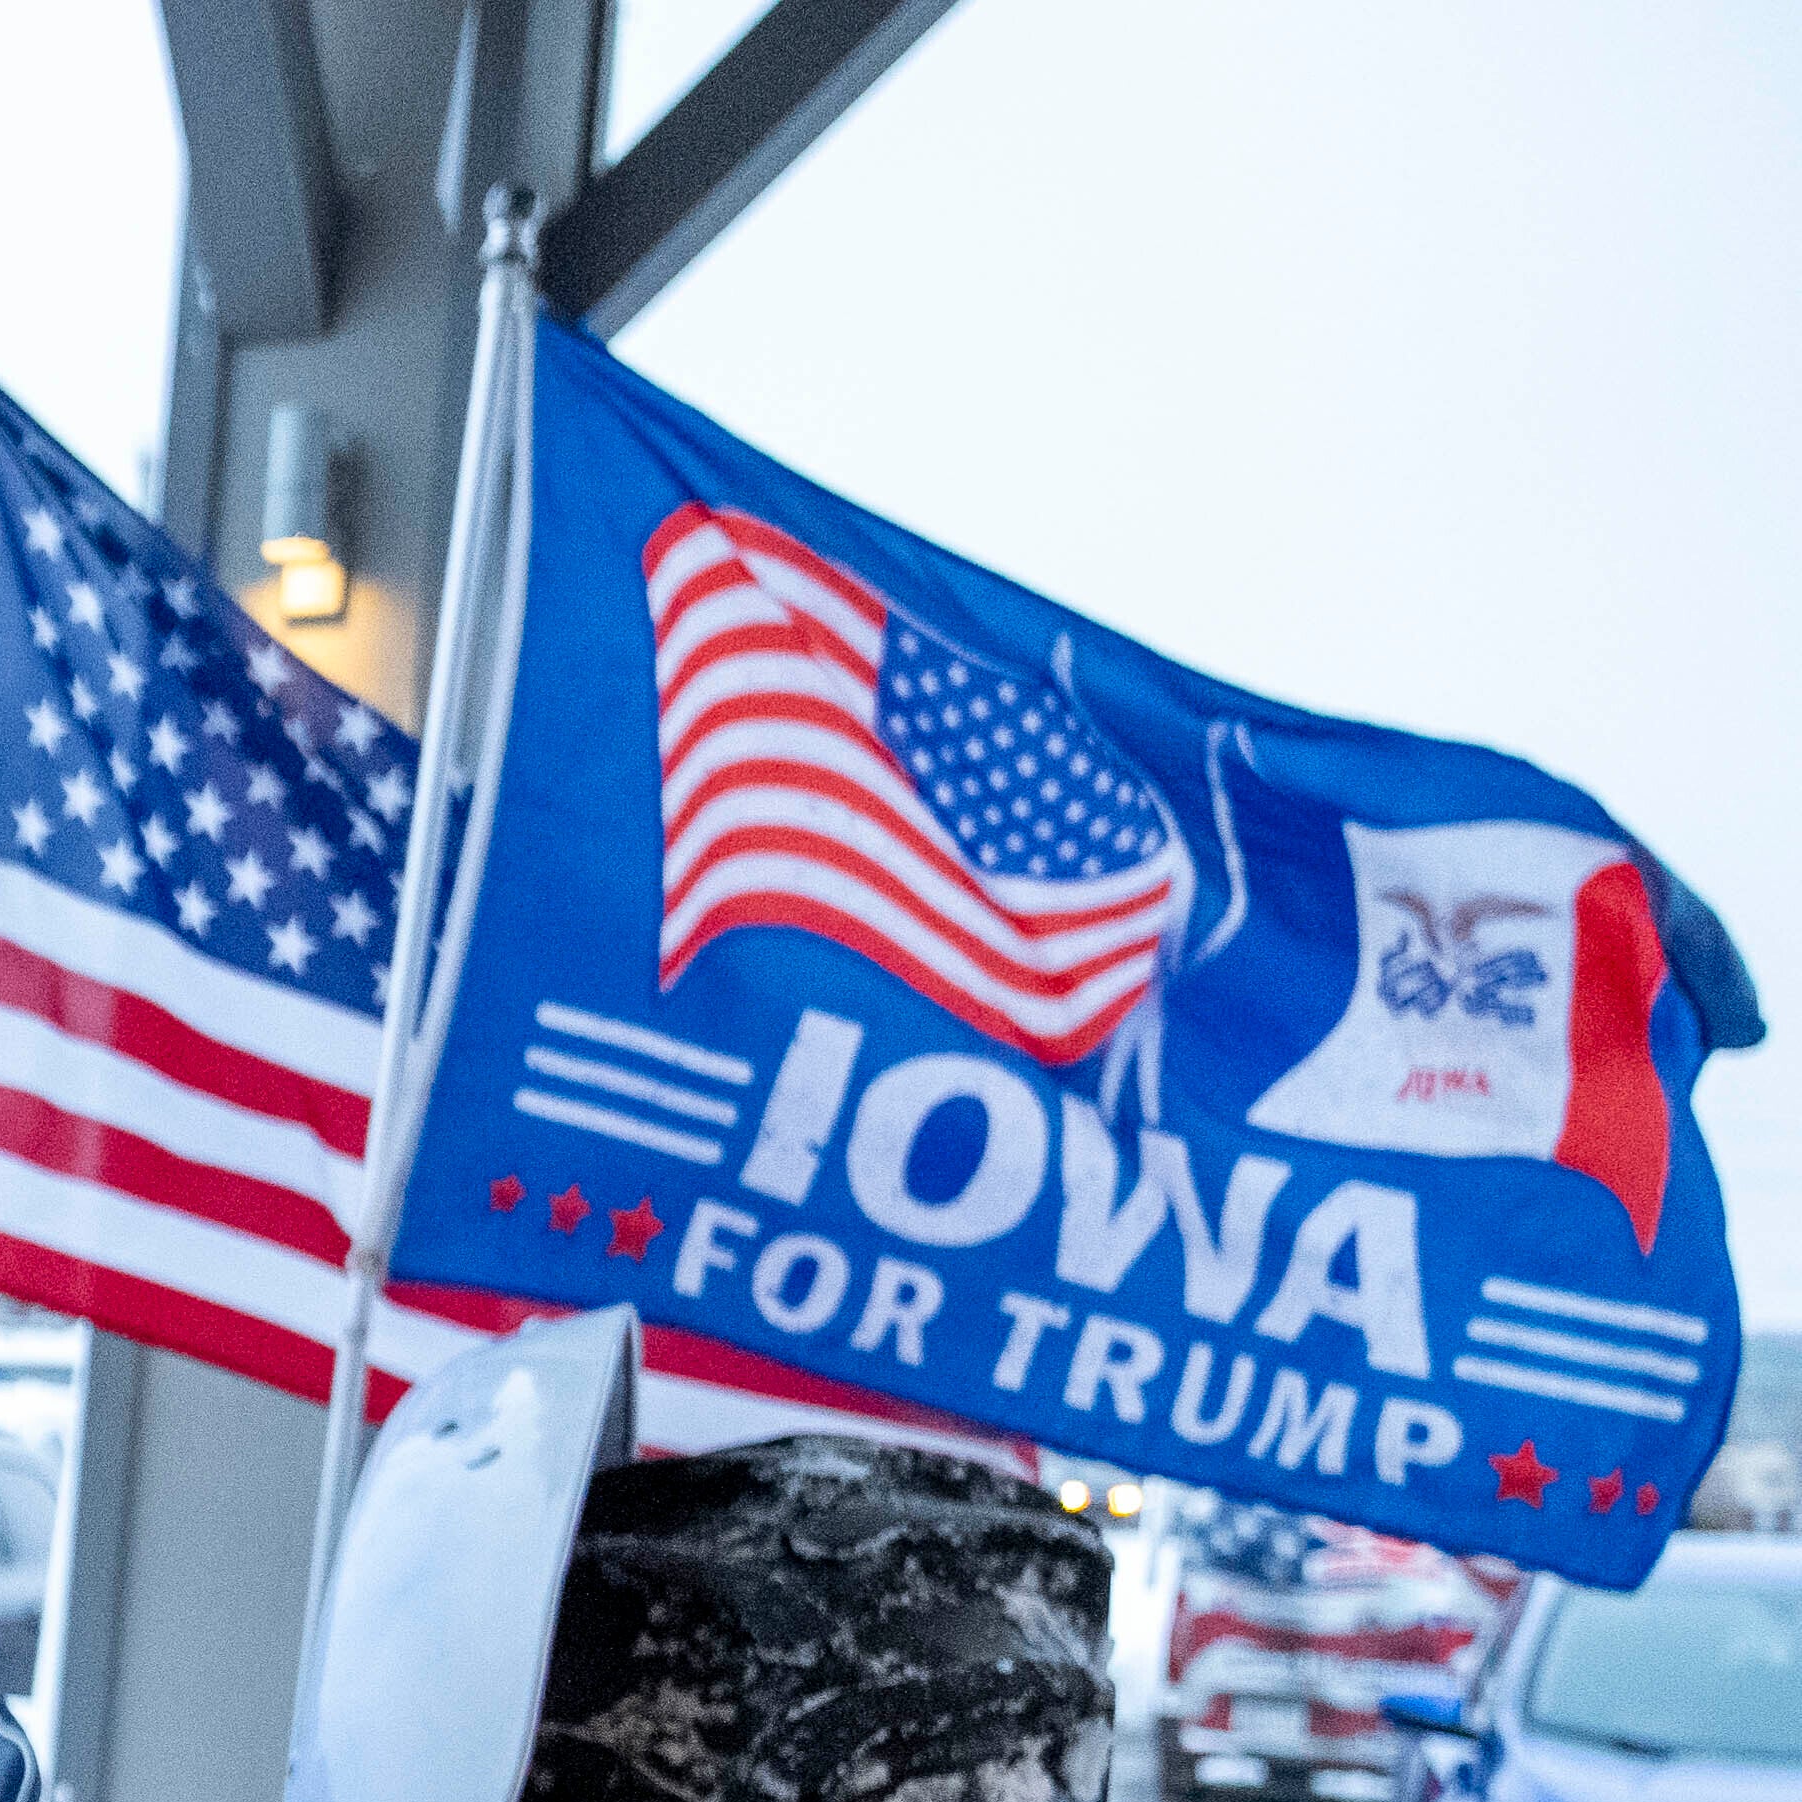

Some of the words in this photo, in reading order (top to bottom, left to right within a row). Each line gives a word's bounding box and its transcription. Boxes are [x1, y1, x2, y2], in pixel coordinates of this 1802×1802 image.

[672, 1198, 946, 1366] FOR
[993, 1291, 1464, 1487] TRUMP
[740, 1007, 1431, 1381] IOWA
